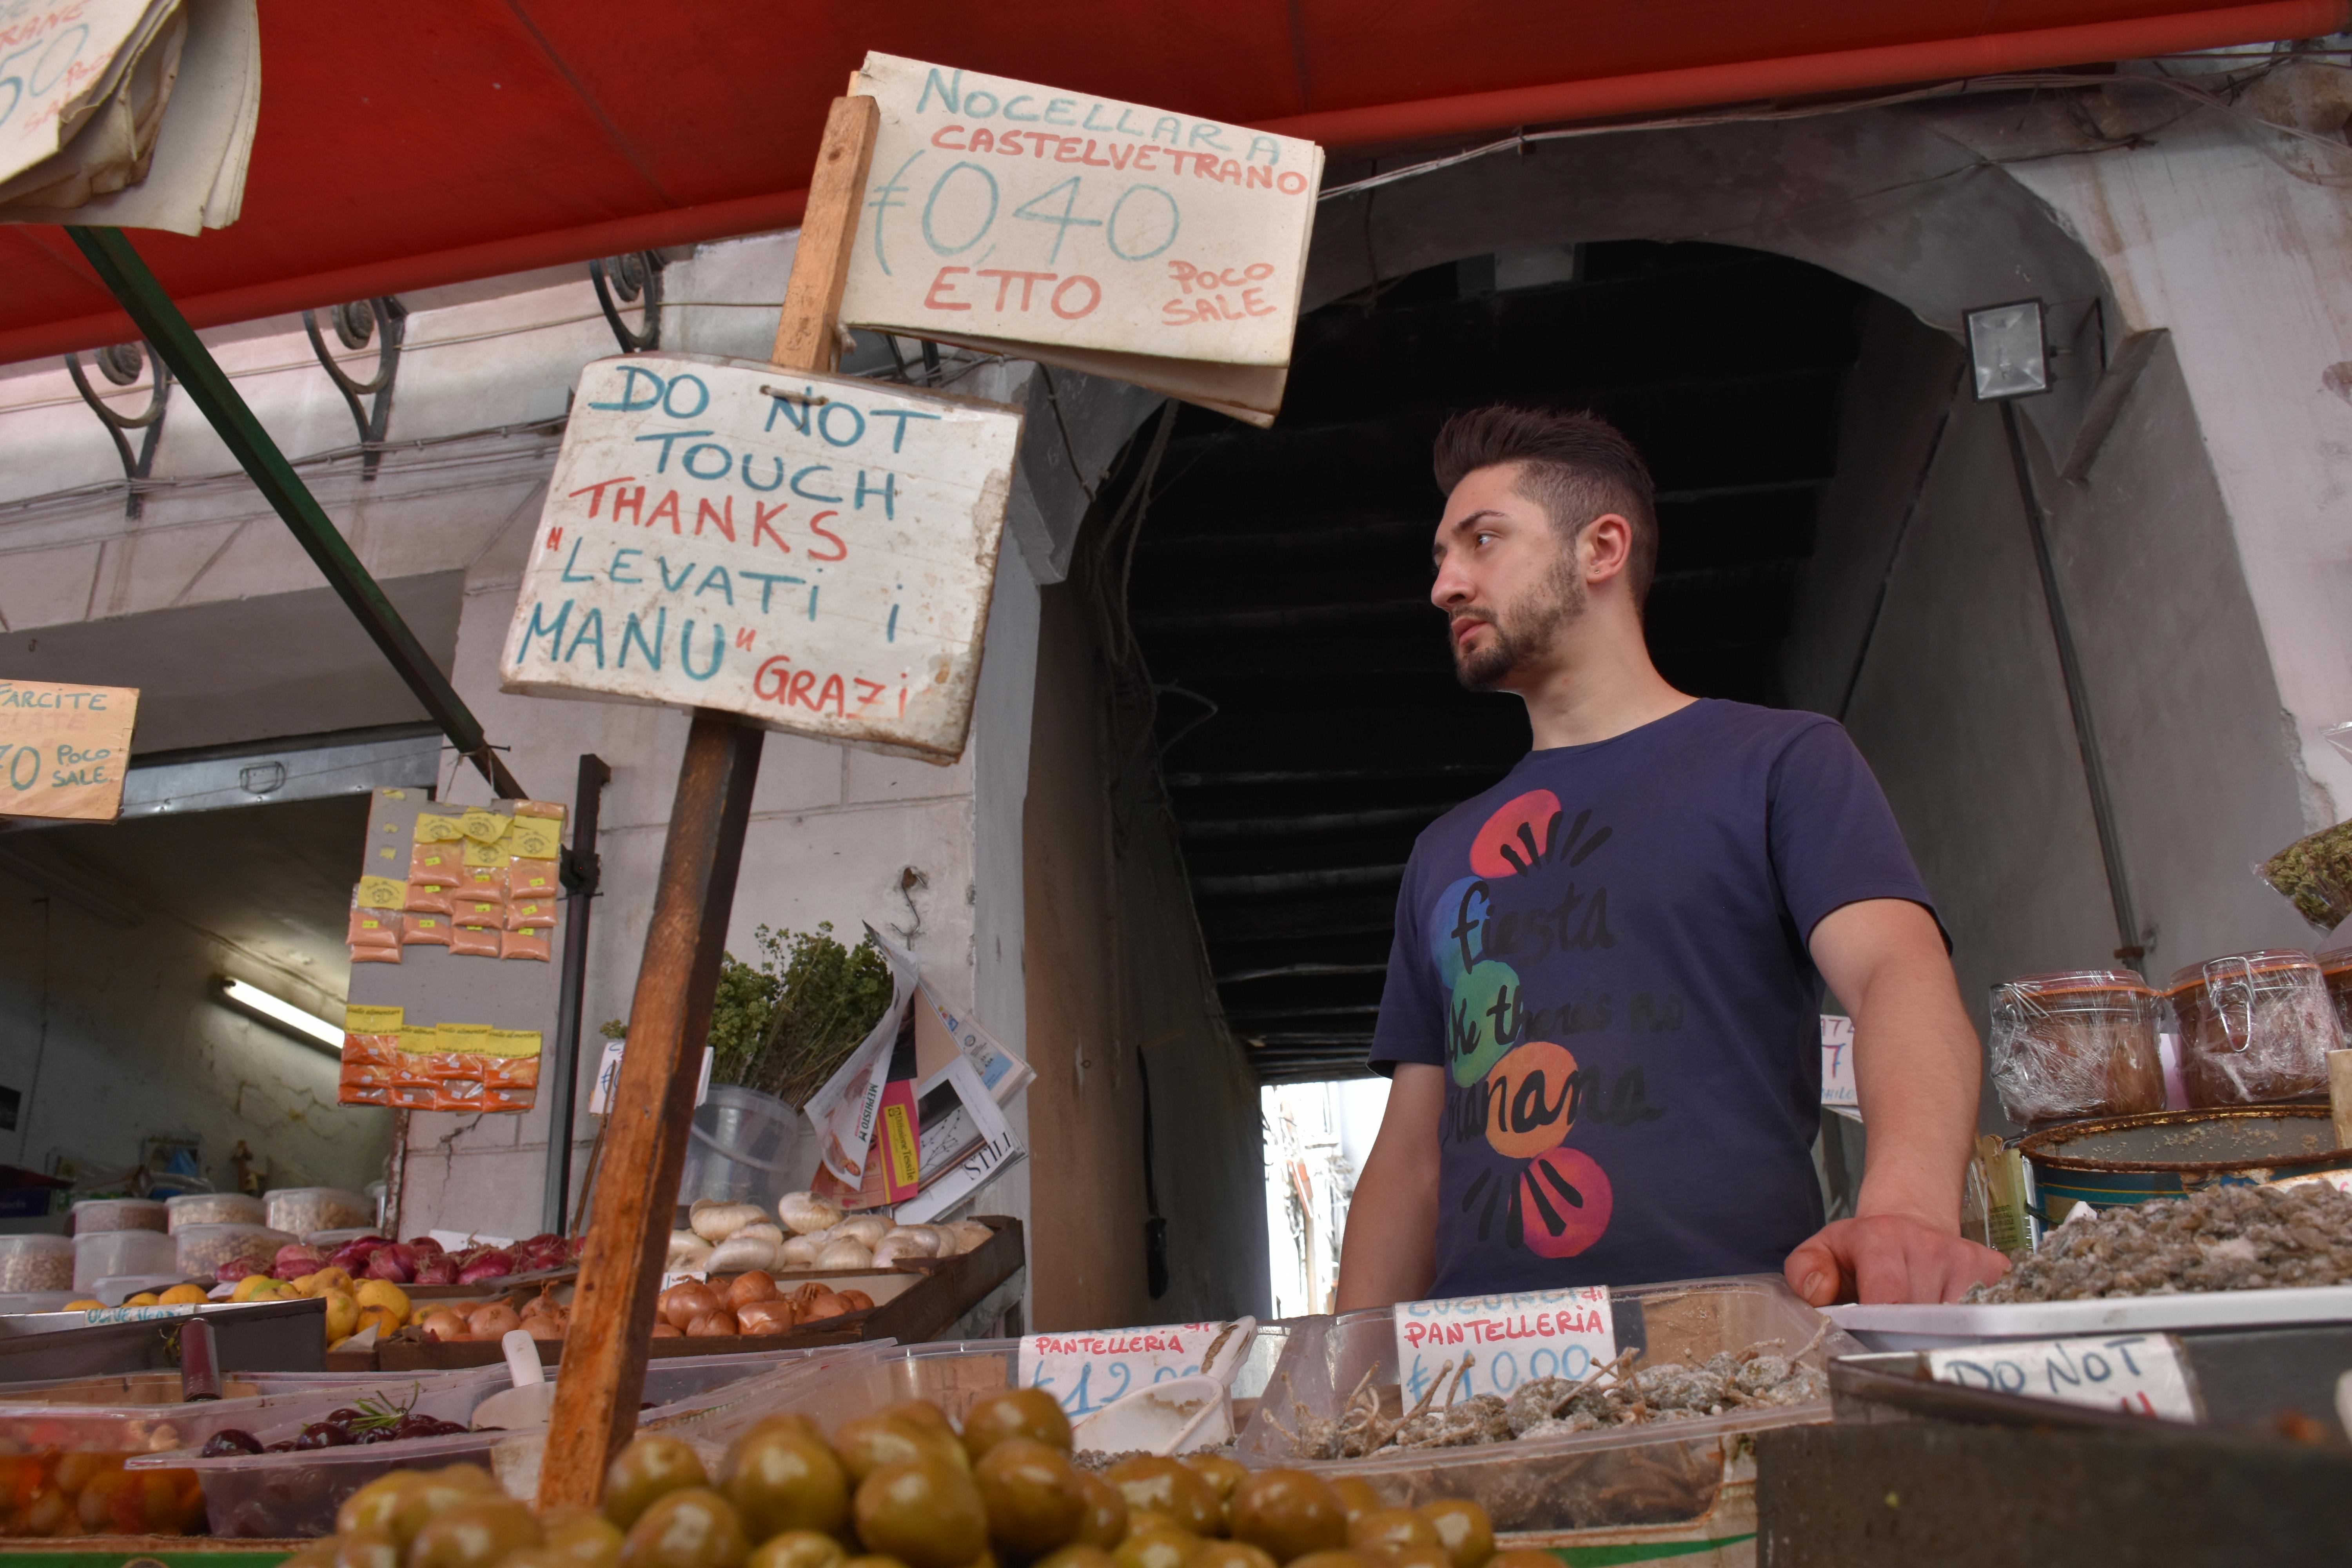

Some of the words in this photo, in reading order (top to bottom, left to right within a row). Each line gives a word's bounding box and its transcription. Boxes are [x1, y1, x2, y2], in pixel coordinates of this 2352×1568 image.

[931, 125, 1308, 196] CASTELVETRANO
[924, 265, 1102, 320] ETTO
[1168, 260, 1274, 294] POCO
[1162, 286, 1278, 326] SALE
[588, 365, 710, 419] DO
[764, 386, 941, 453] NOT
[635, 430, 895, 520] TOUCH
[569, 476, 848, 562] THANKS
[52, 766, 110, 788] SALE
[1451, 880, 1618, 975] fiesta
[861, 1082, 878, 1132] MEPHISTO
[902, 1150, 914, 1181] Tessile
[1945, 1359, 2026, 1394] DO
[2046, 1337, 2147, 1394] NOT
